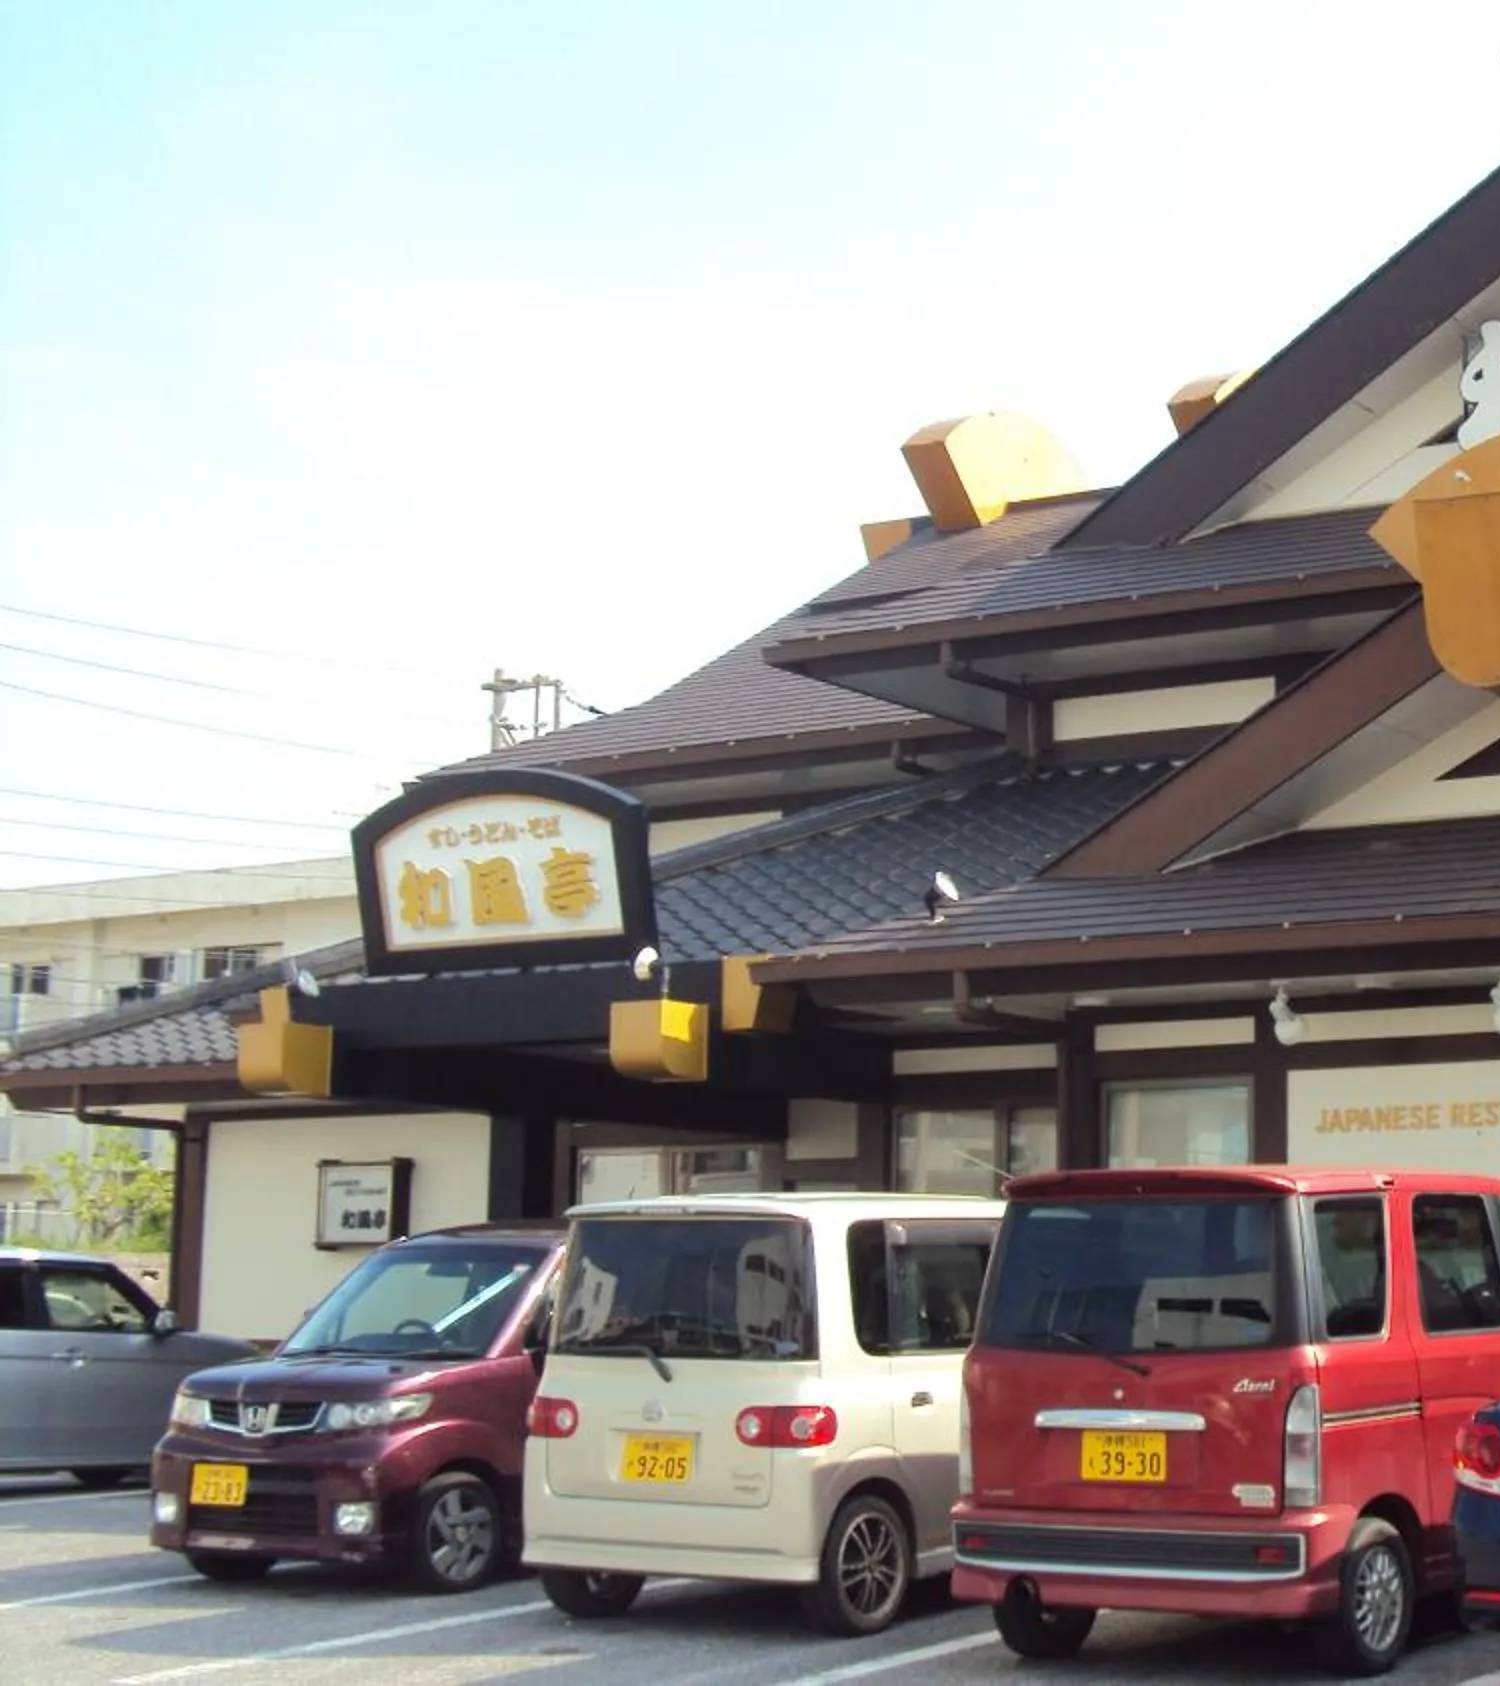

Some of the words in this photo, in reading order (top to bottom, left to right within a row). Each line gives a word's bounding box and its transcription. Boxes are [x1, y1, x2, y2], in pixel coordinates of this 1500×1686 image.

[398, 847, 601, 931] 和風亭
[1315, 1104, 1441, 1133] JAPANESE
[636, 1455, 687, 1479] 92-05
